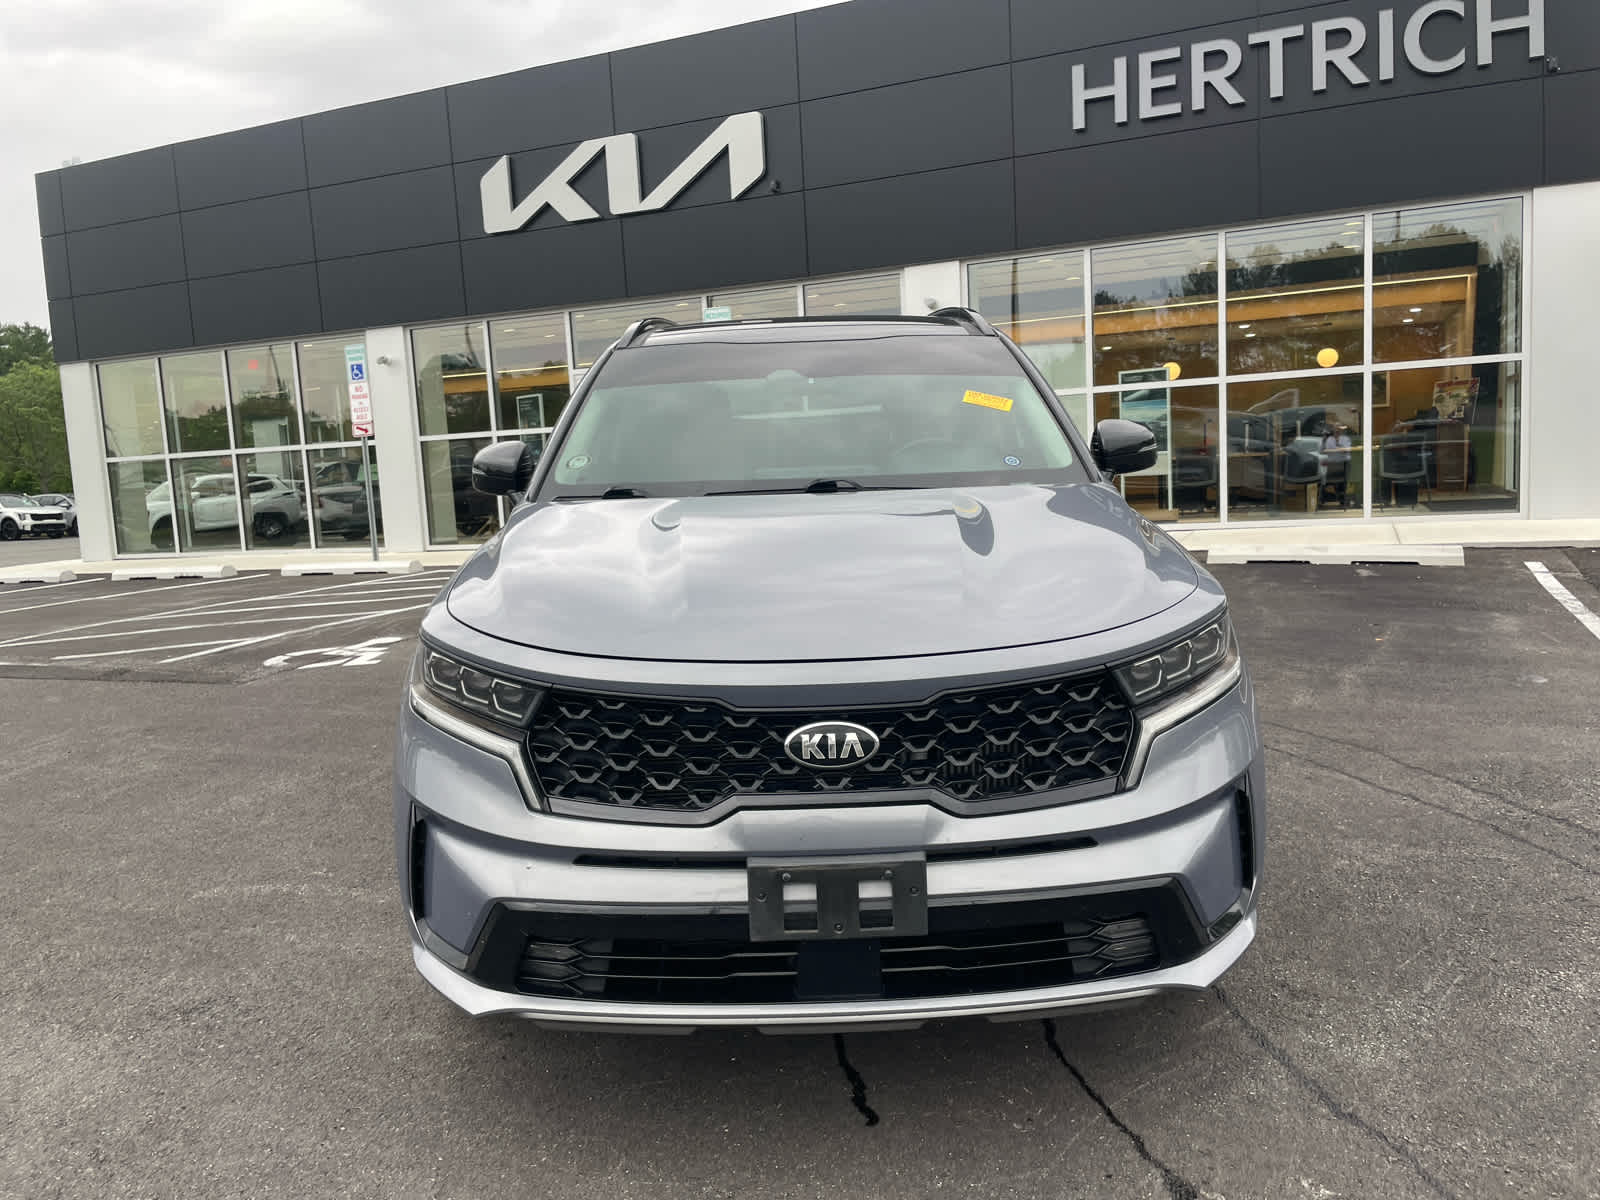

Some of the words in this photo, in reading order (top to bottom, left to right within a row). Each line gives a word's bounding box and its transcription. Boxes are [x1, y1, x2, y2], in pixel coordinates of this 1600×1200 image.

[1071, 0, 1545, 130] HERTRICH
[480, 111, 764, 234] KIA
[801, 732, 865, 759] KIA
